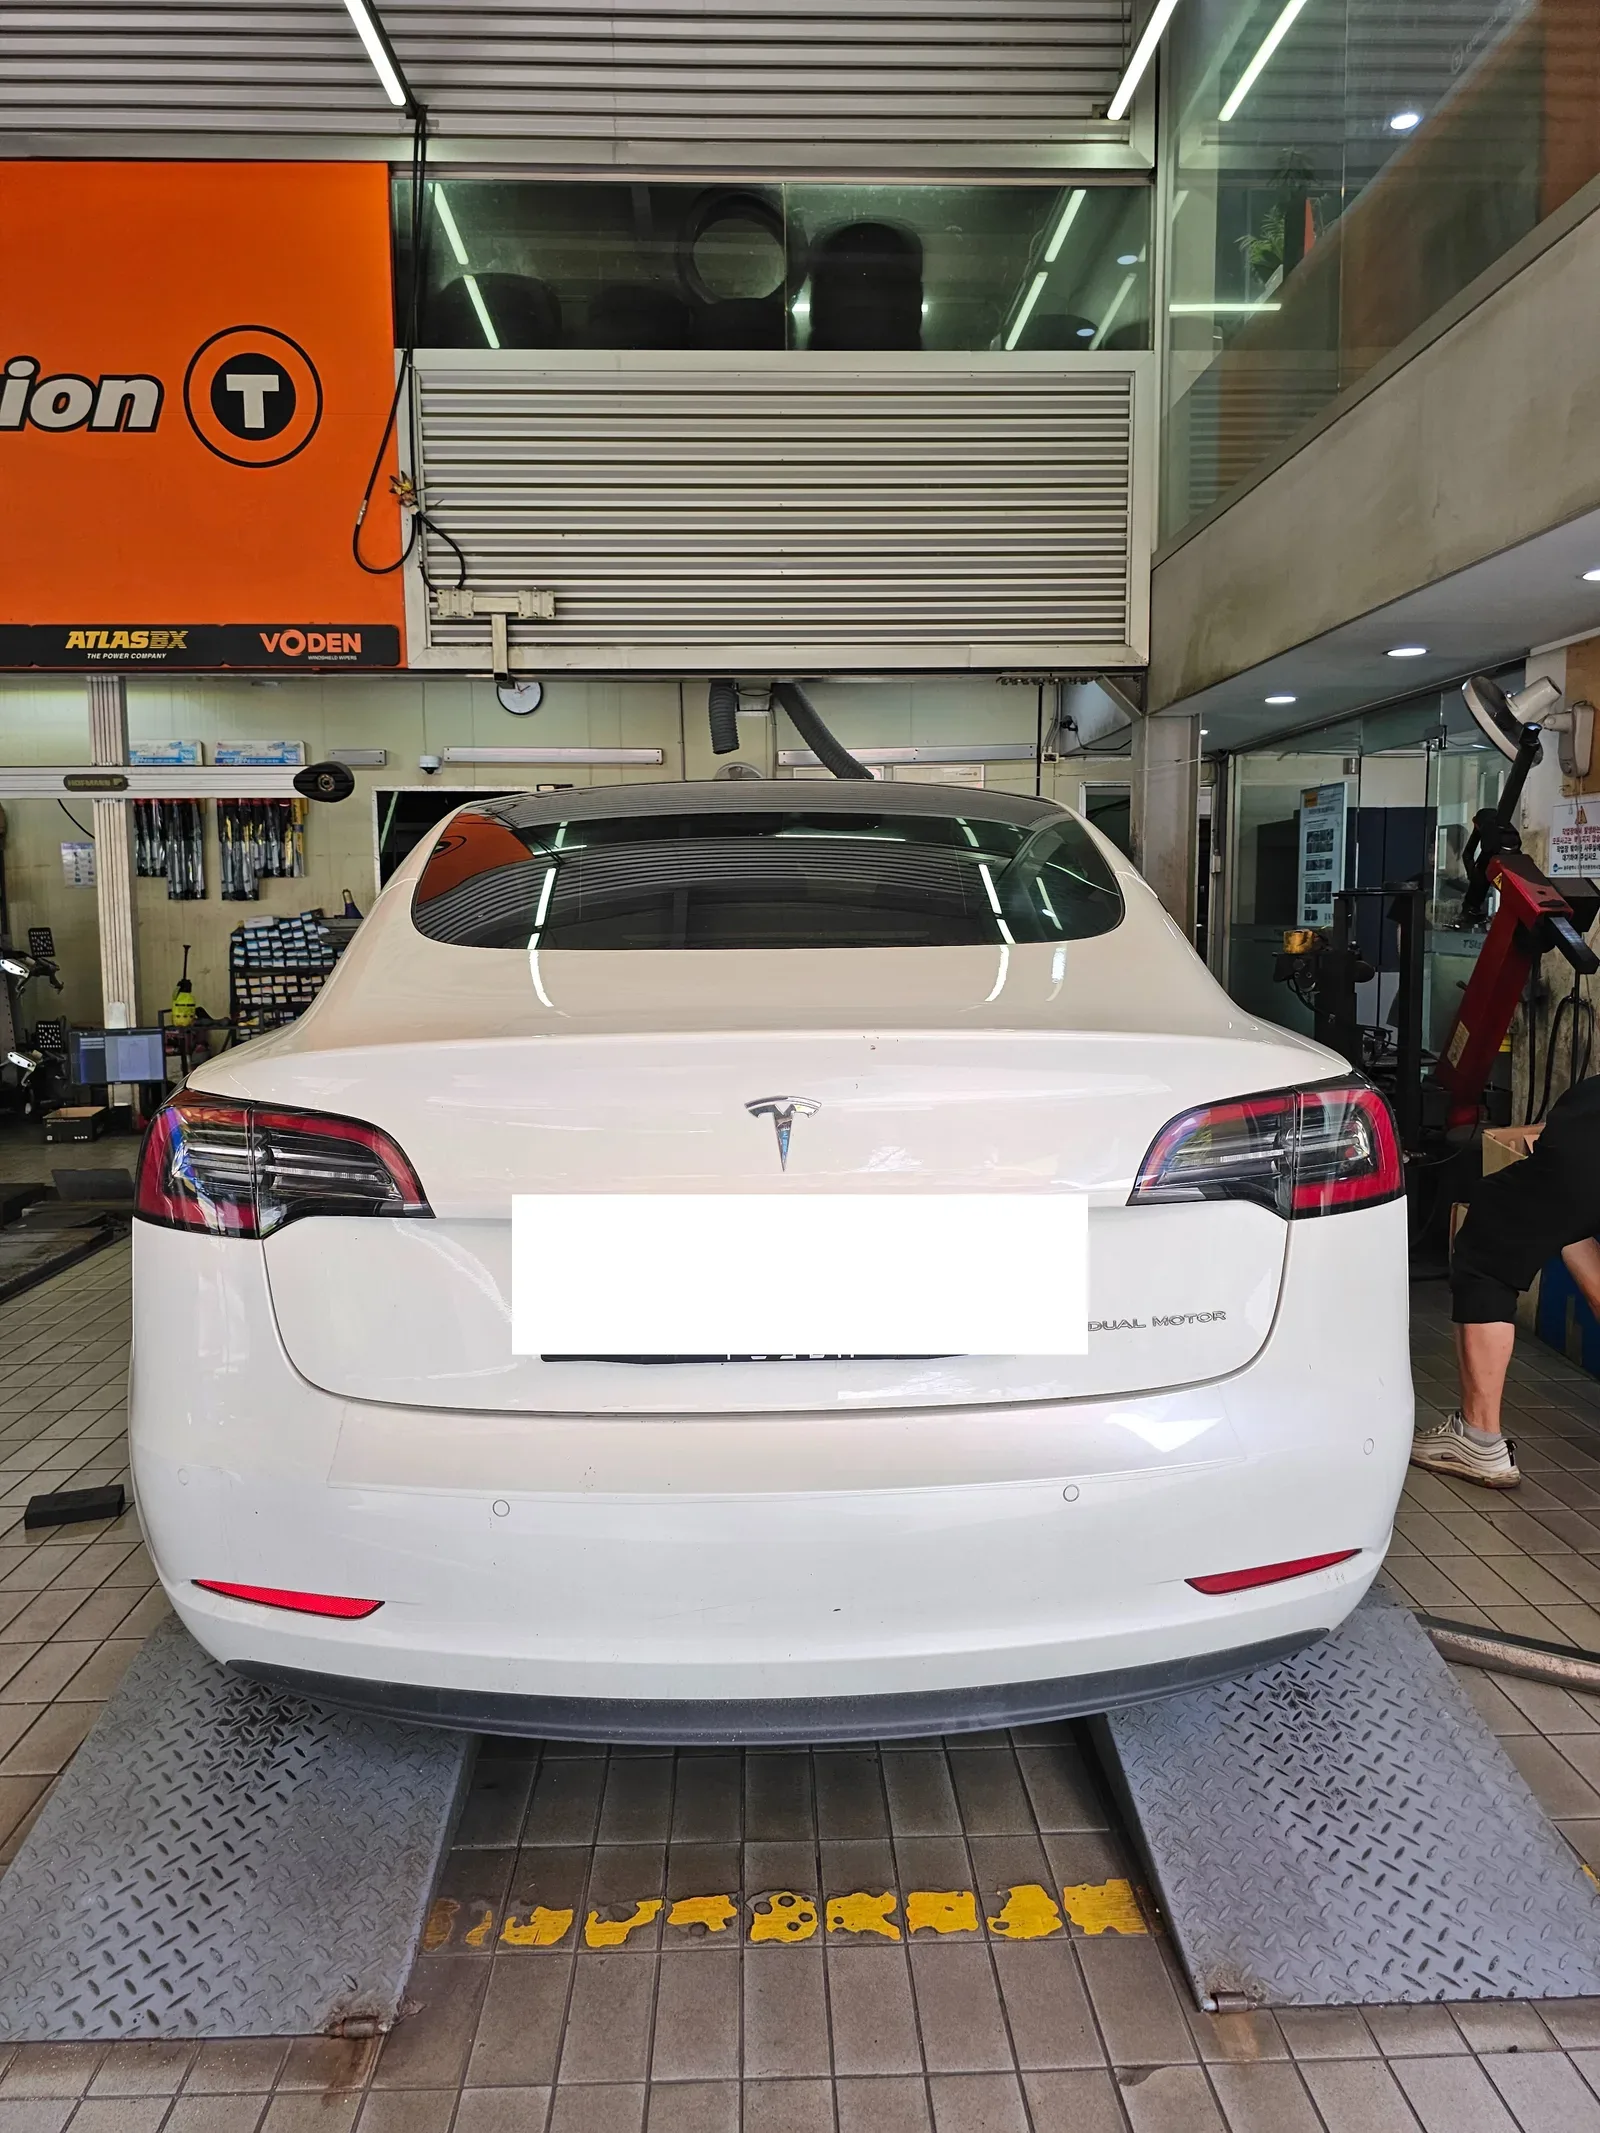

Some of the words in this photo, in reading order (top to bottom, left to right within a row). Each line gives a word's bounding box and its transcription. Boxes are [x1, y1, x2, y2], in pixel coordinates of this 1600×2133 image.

[65, 631, 188, 648] ATLASBX
[259, 629, 362, 657] VODEN
[1088, 1319, 1146, 1331] DUAL
[1152, 1310, 1226, 1327] MOTOR
